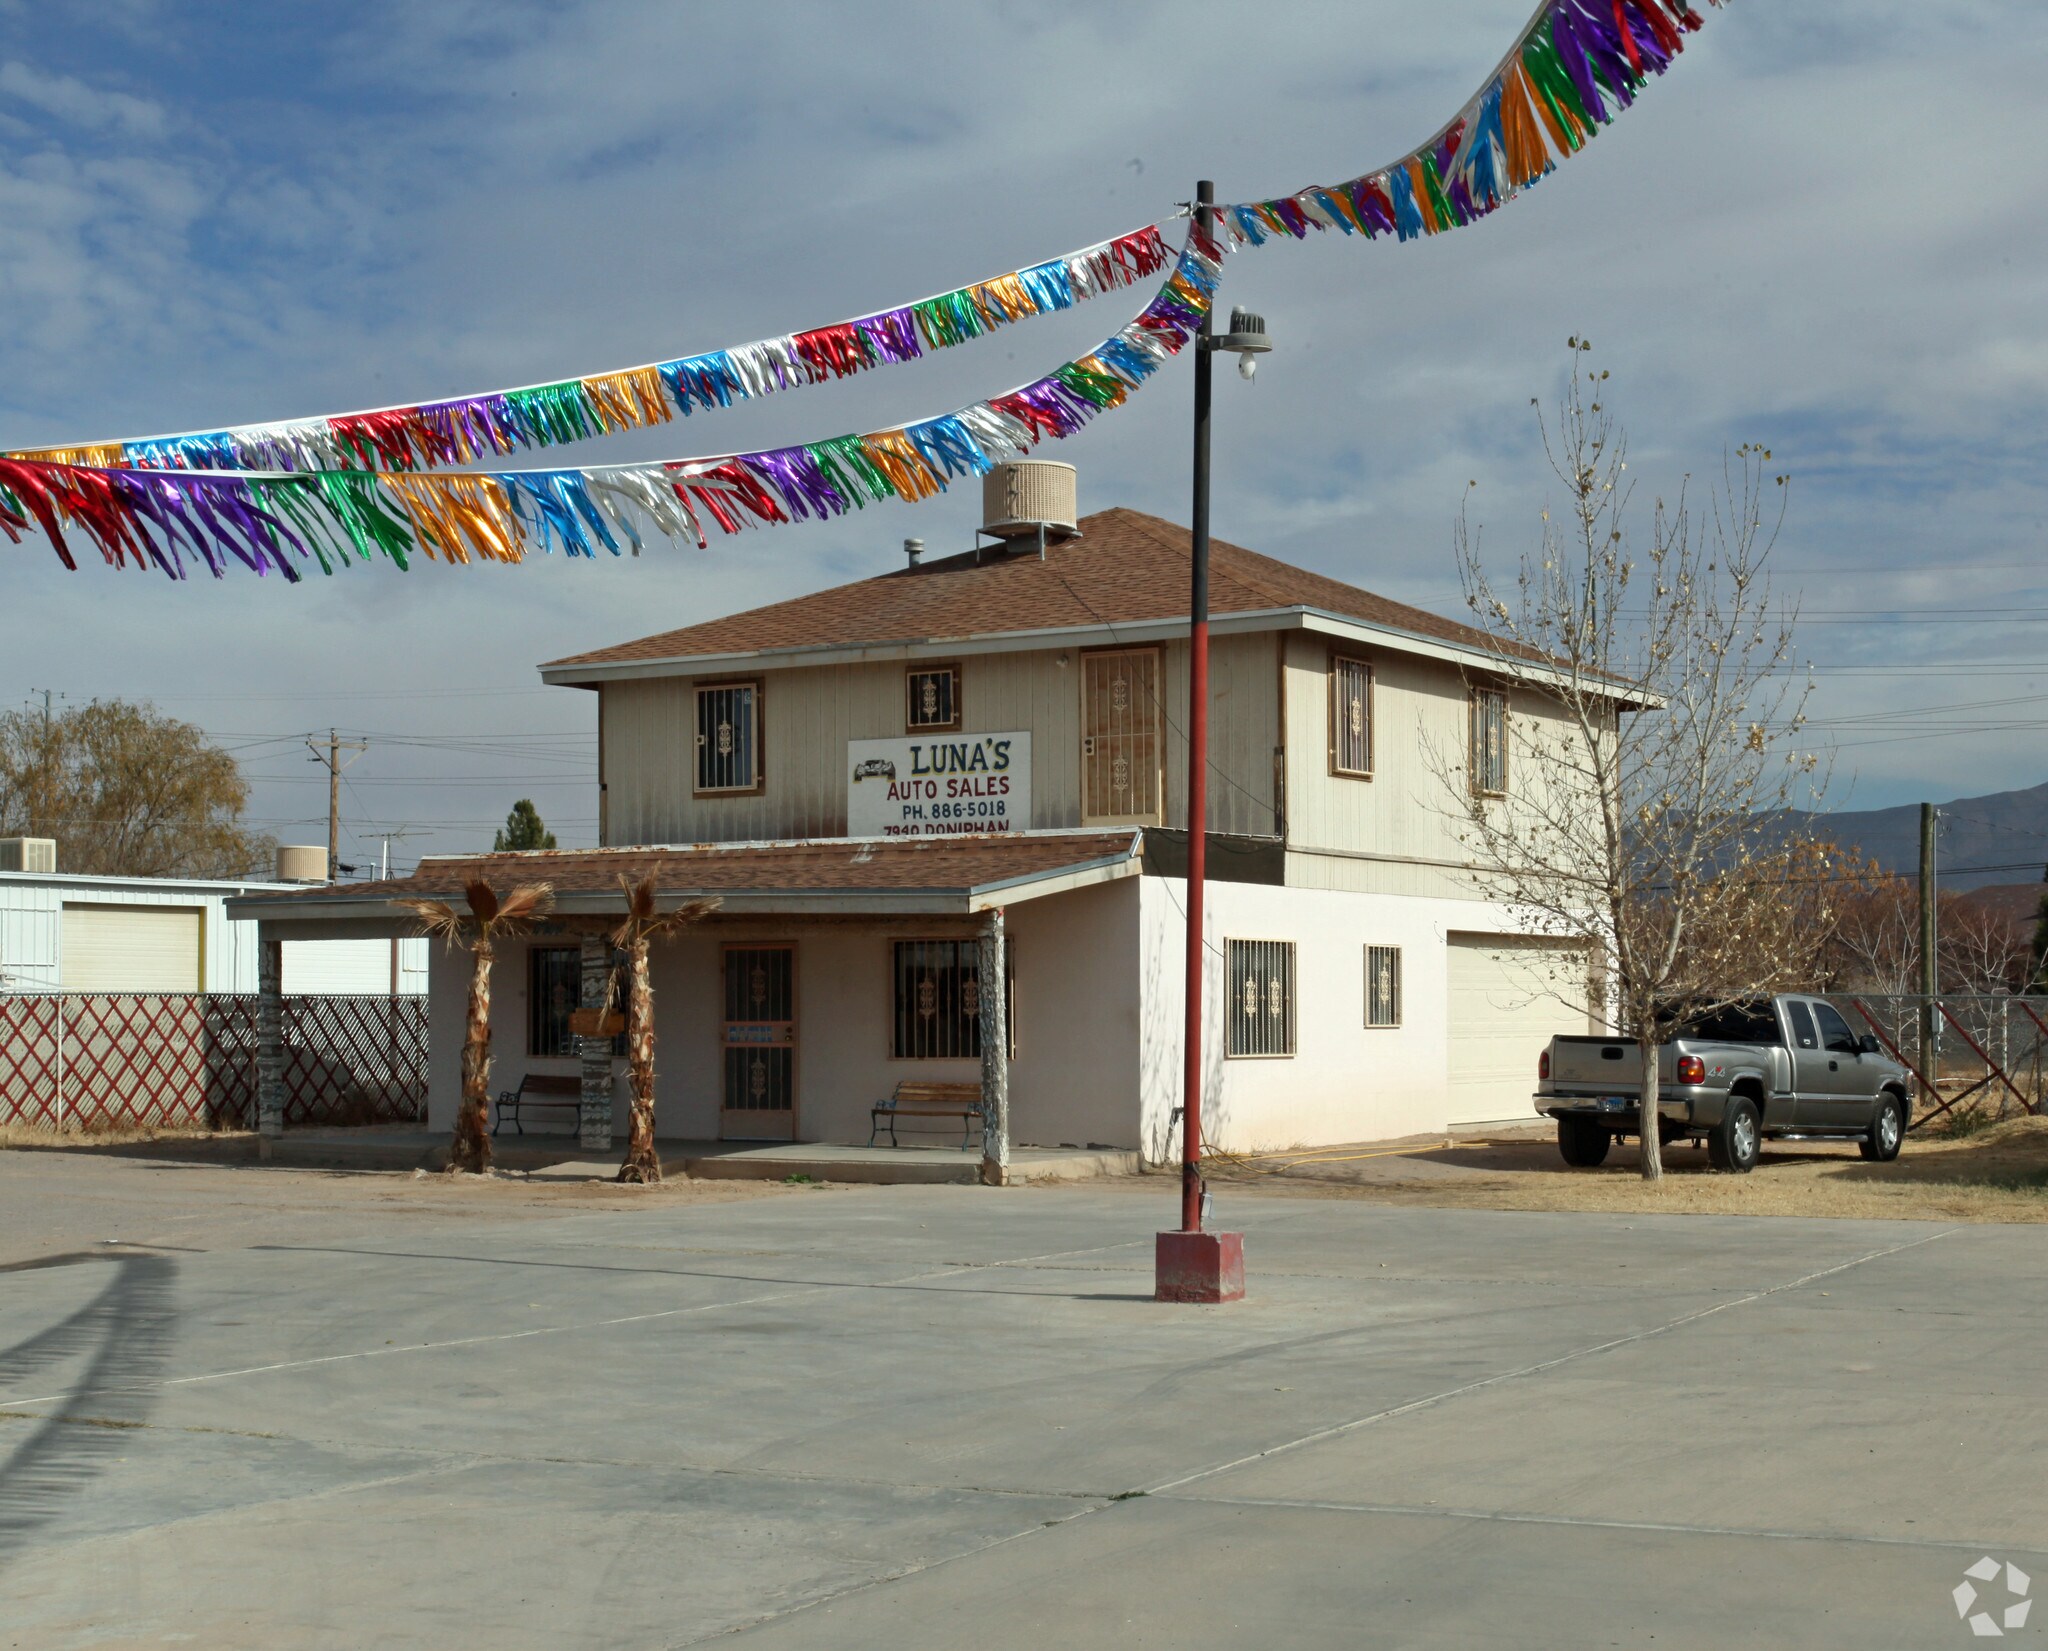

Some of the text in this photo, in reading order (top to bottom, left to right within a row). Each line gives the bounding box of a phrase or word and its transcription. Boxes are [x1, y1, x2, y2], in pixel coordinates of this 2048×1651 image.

[910, 738, 1012, 776] LUNA'S
[887, 776, 1010, 801] AUTO SALES
[903, 800, 1006, 820] PH. 886-5018
[925, 819, 1010, 835] DONIPHAN
